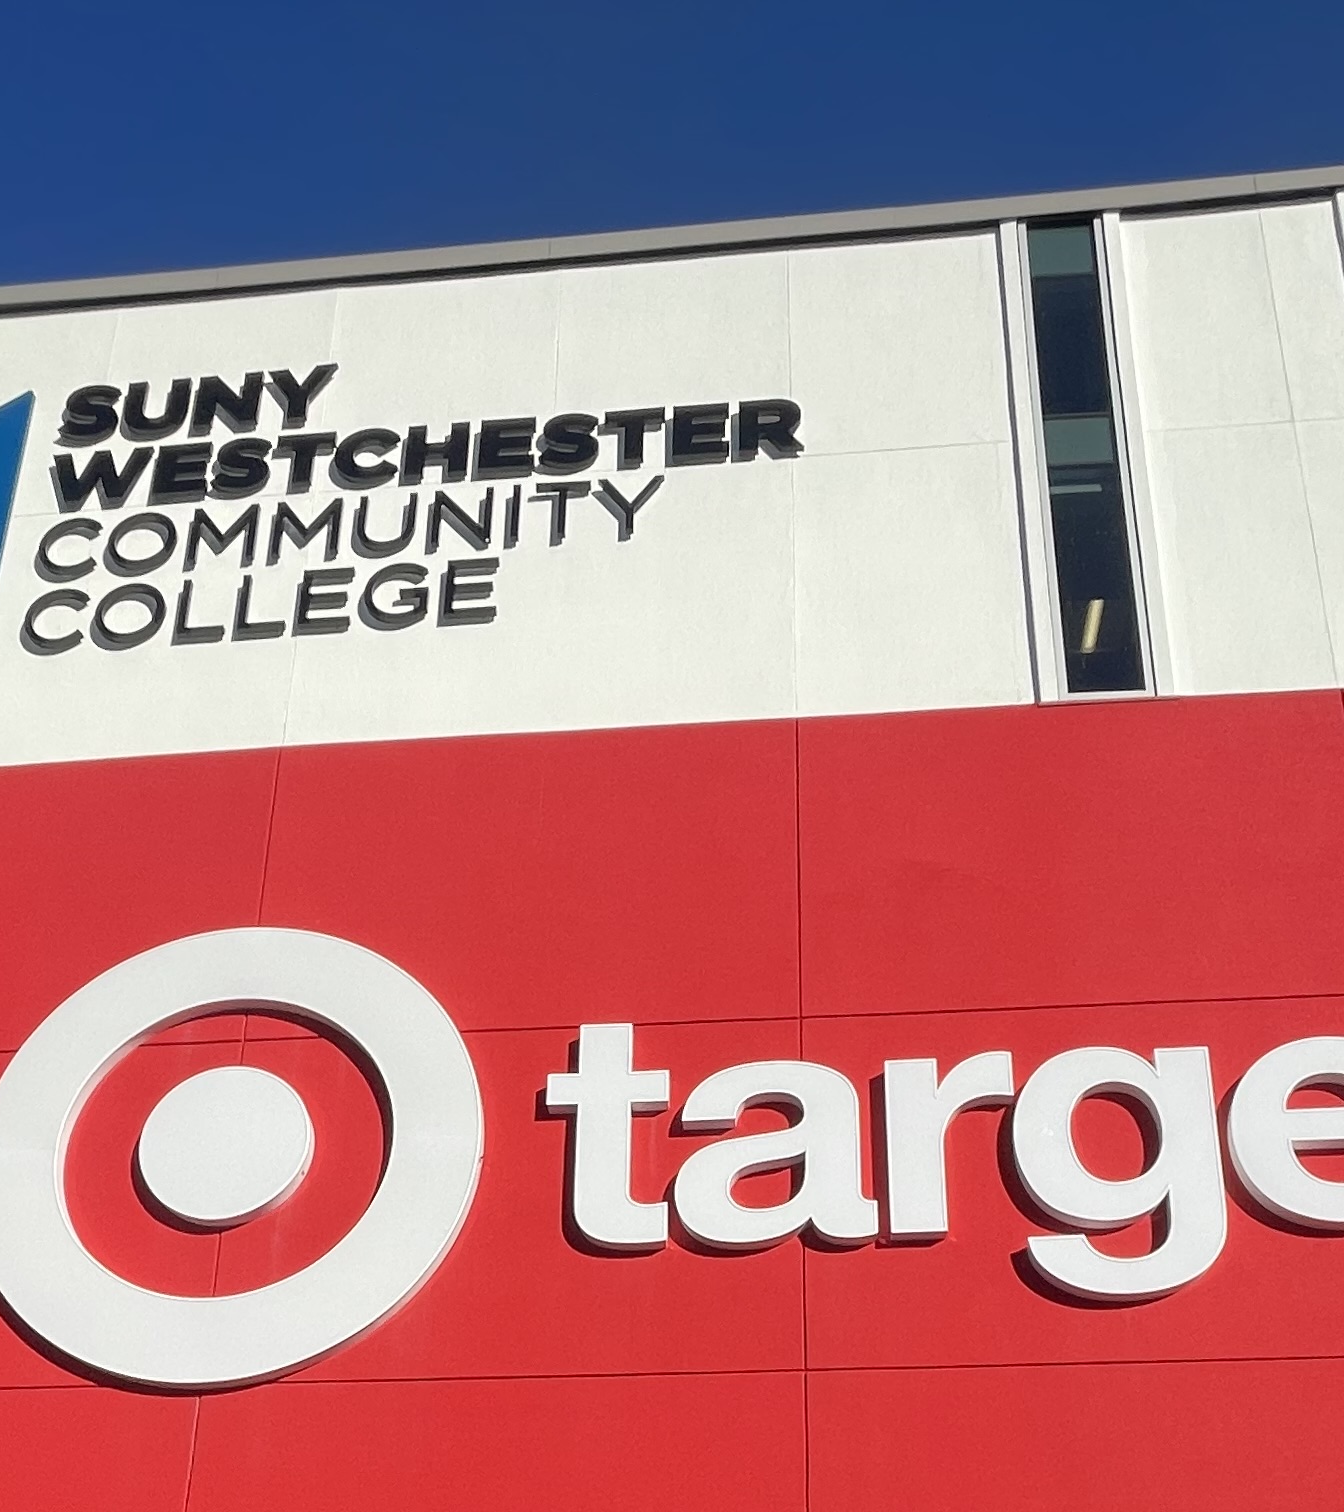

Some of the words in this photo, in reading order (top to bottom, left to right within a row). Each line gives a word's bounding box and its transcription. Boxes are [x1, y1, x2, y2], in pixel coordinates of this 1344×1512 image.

[54, 399, 803, 511] WESTCHESTER
[56, 364, 338, 445] SUNY
[35, 475, 665, 582] COMMUNITY
[22, 557, 500, 655] COLLEGE
